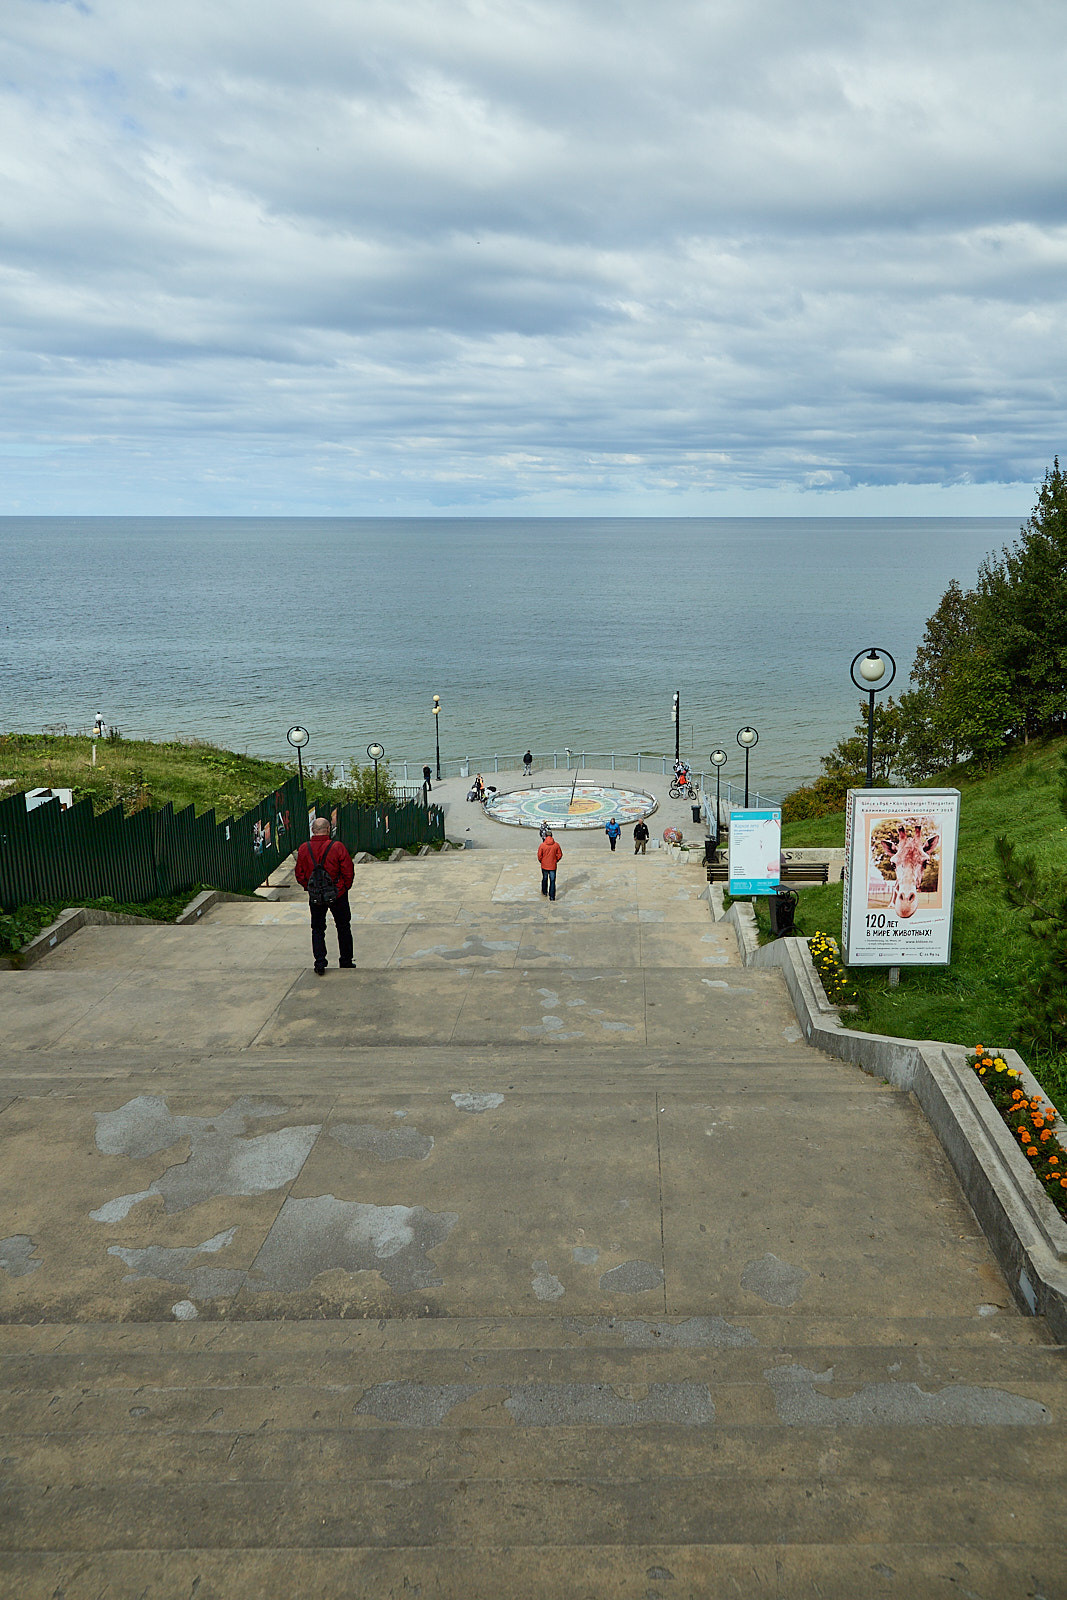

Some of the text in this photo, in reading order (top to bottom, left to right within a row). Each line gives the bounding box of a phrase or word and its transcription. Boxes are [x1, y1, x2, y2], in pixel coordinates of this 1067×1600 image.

[865, 914, 886, 928] 120
[887, 920, 899, 928] ЛЕТ
[866, 929, 933, 937] В МИРЕ ЖИВОТНЫХ!
